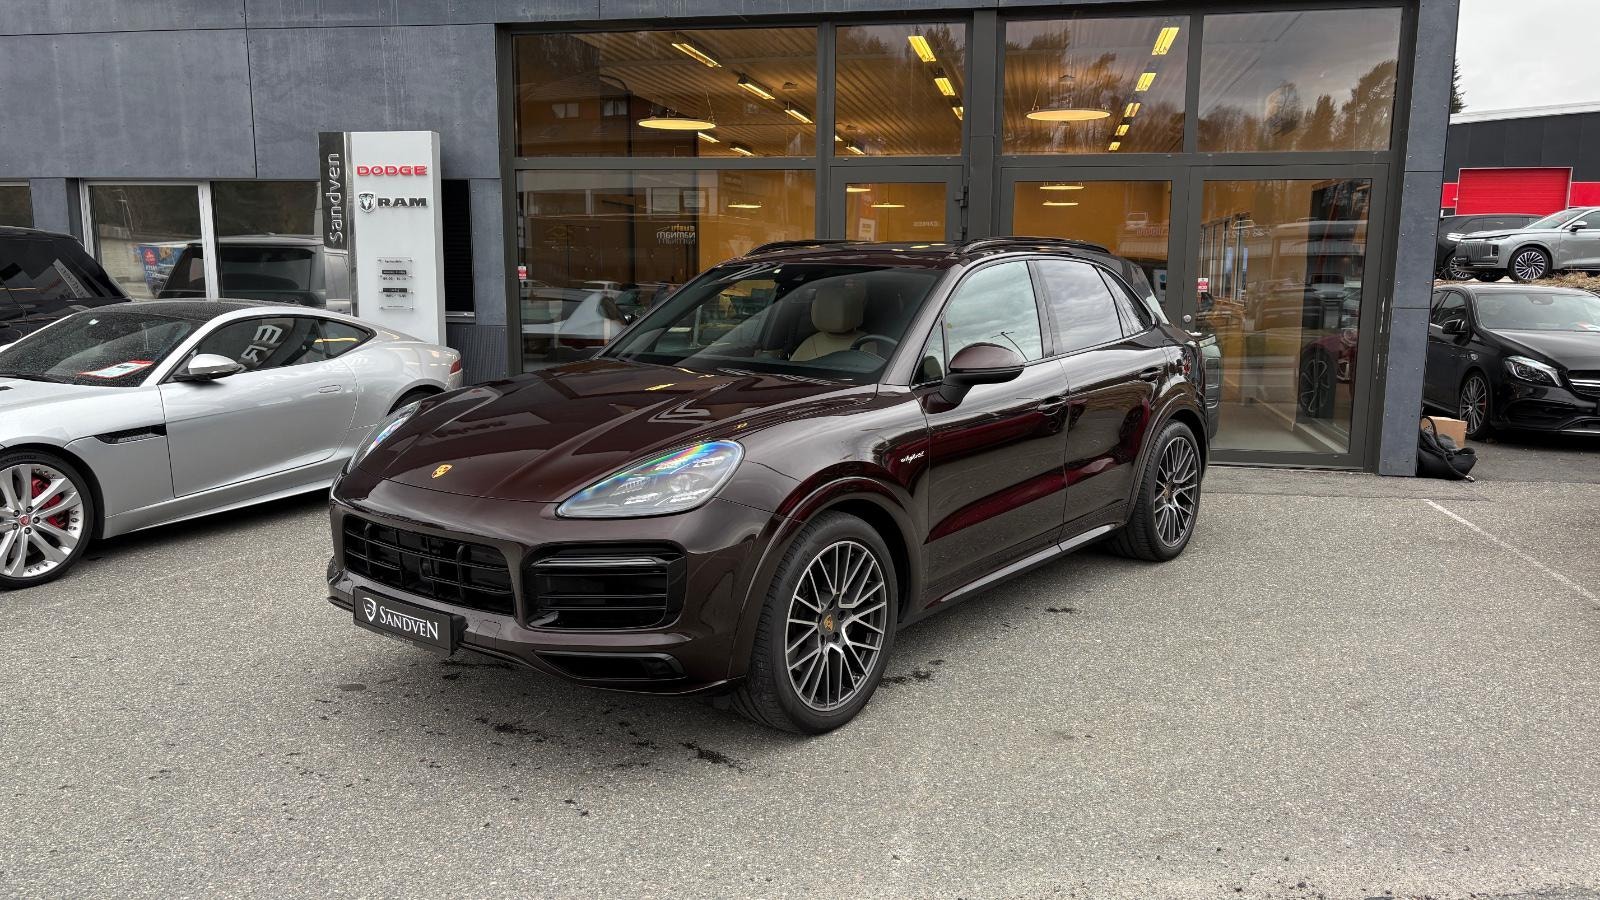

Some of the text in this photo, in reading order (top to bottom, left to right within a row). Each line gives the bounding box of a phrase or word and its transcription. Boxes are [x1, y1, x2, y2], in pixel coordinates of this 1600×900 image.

[356, 165, 427, 176] DODGE
[325, 153, 343, 244] Sandven
[378, 197, 427, 207] RAM
[379, 605, 439, 640] SANDVEN
